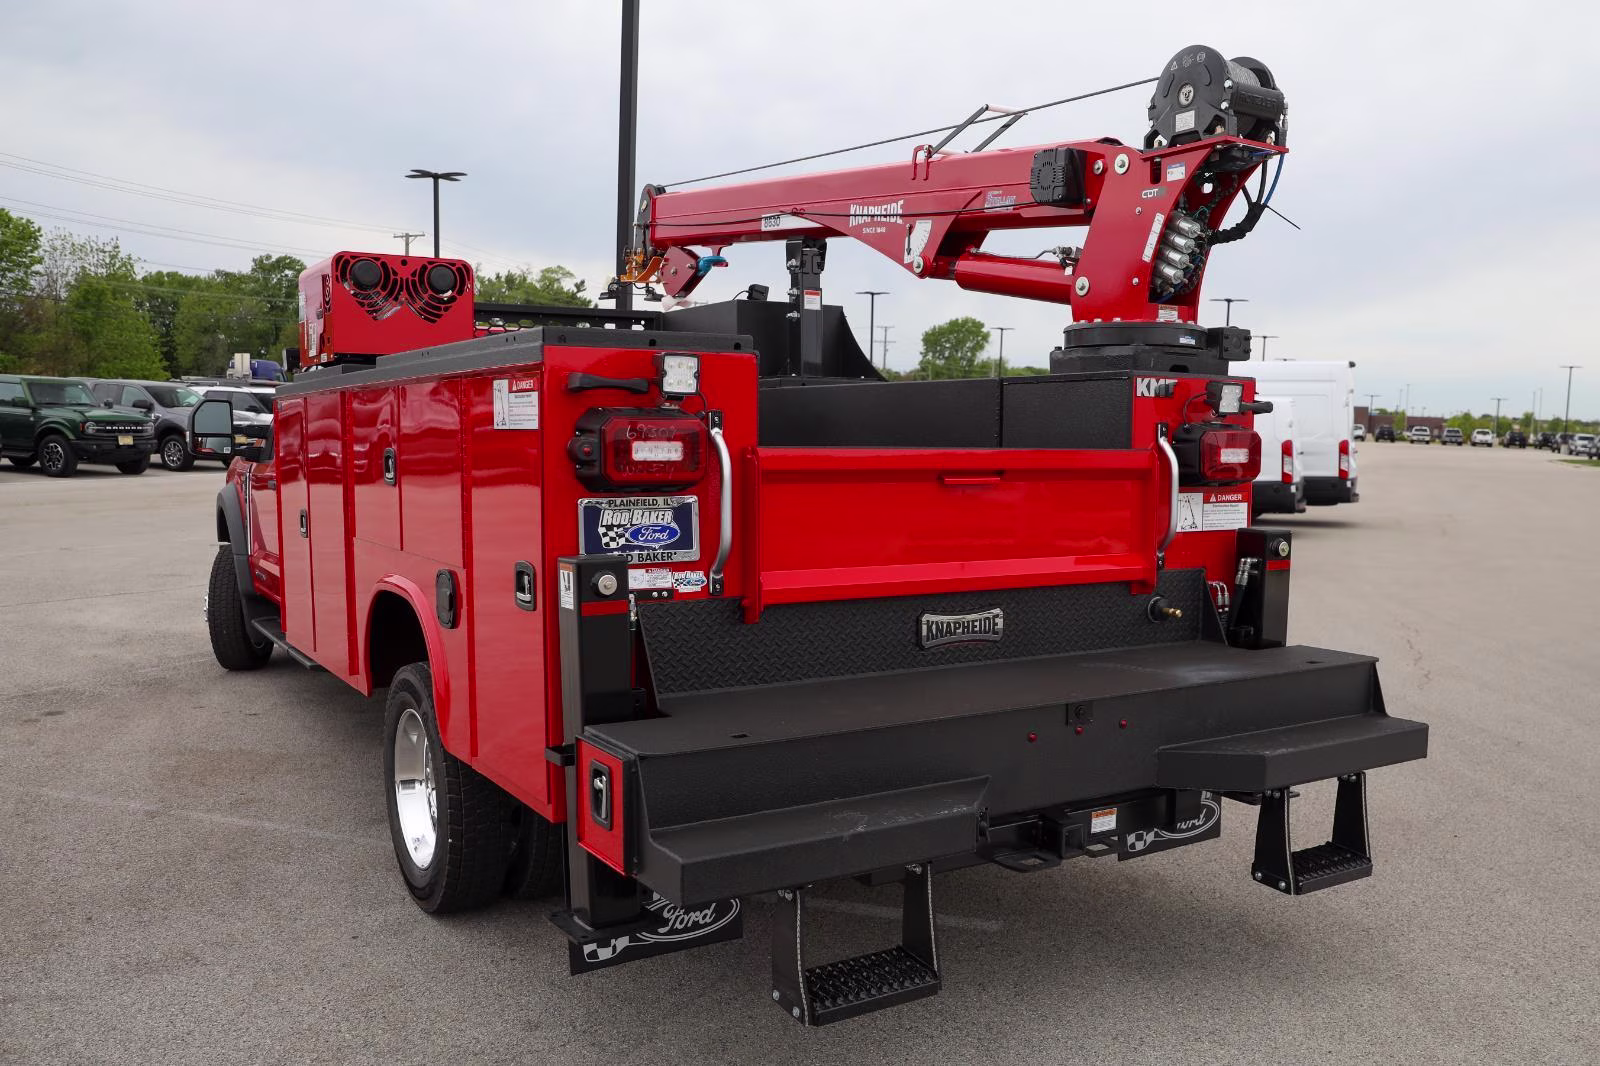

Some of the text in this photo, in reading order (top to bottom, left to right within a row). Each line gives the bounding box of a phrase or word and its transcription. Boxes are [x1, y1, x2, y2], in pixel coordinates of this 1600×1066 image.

[849, 200, 904, 227] KNAPHEIDE
[516, 380, 534, 390] DANGER
[1136, 377, 1178, 397] KMT
[608, 498, 671, 508] PLAINFIELD, IL
[602, 509, 673, 525] ROD BAKER
[638, 526, 669, 541] Ford
[637, 551, 674, 563] BAKER
[926, 613, 1000, 642] KNAPHEIDE
[657, 903, 717, 934] Ford
